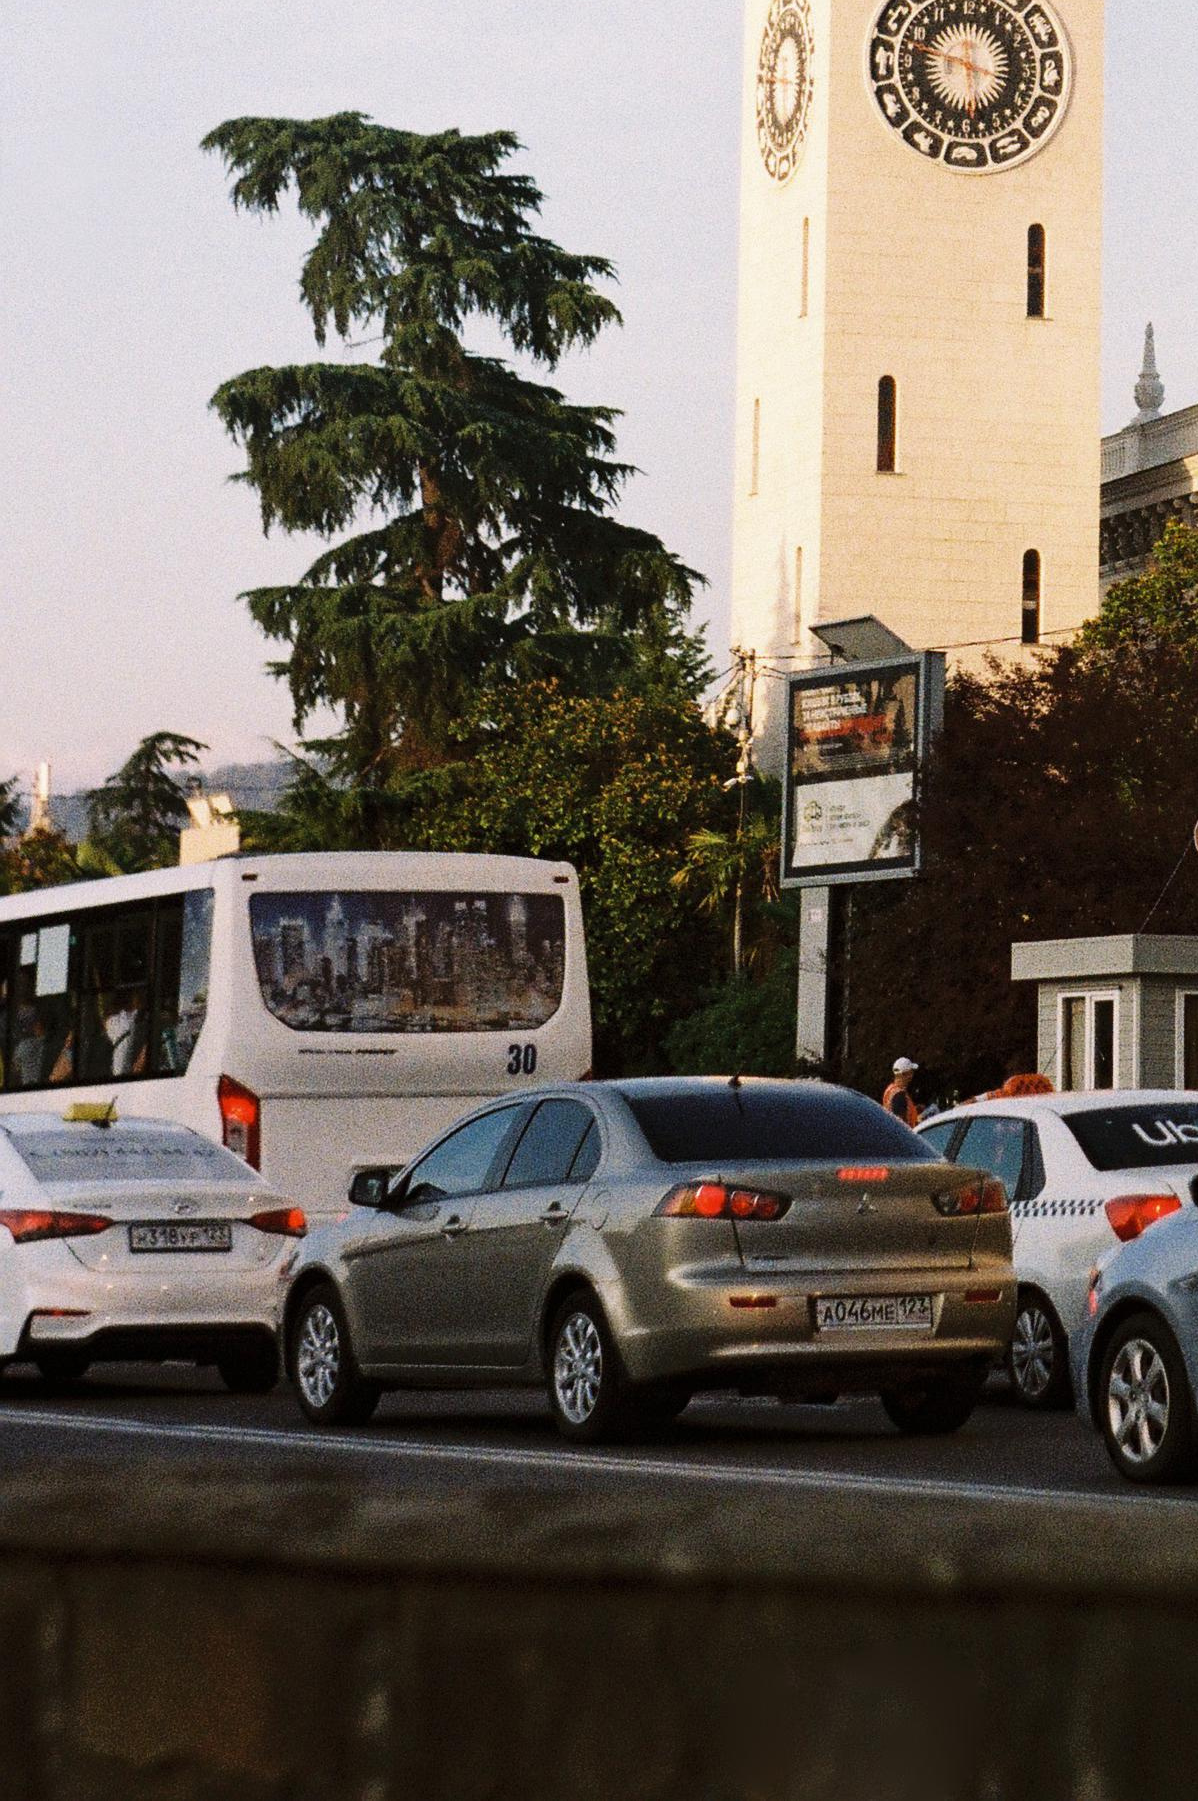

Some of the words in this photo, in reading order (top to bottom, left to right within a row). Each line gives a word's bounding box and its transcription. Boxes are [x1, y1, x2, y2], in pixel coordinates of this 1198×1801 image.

[963, 1, 975, 15] 12
[934, 8, 945, 22] 11
[994, 12, 1001, 25] 1
[913, 27, 926, 40] 10
[1013, 33, 1022, 47] 2
[904, 57, 913, 68] 9
[962, 120, 971, 133] 6
[507, 1043, 538, 1075] 30
